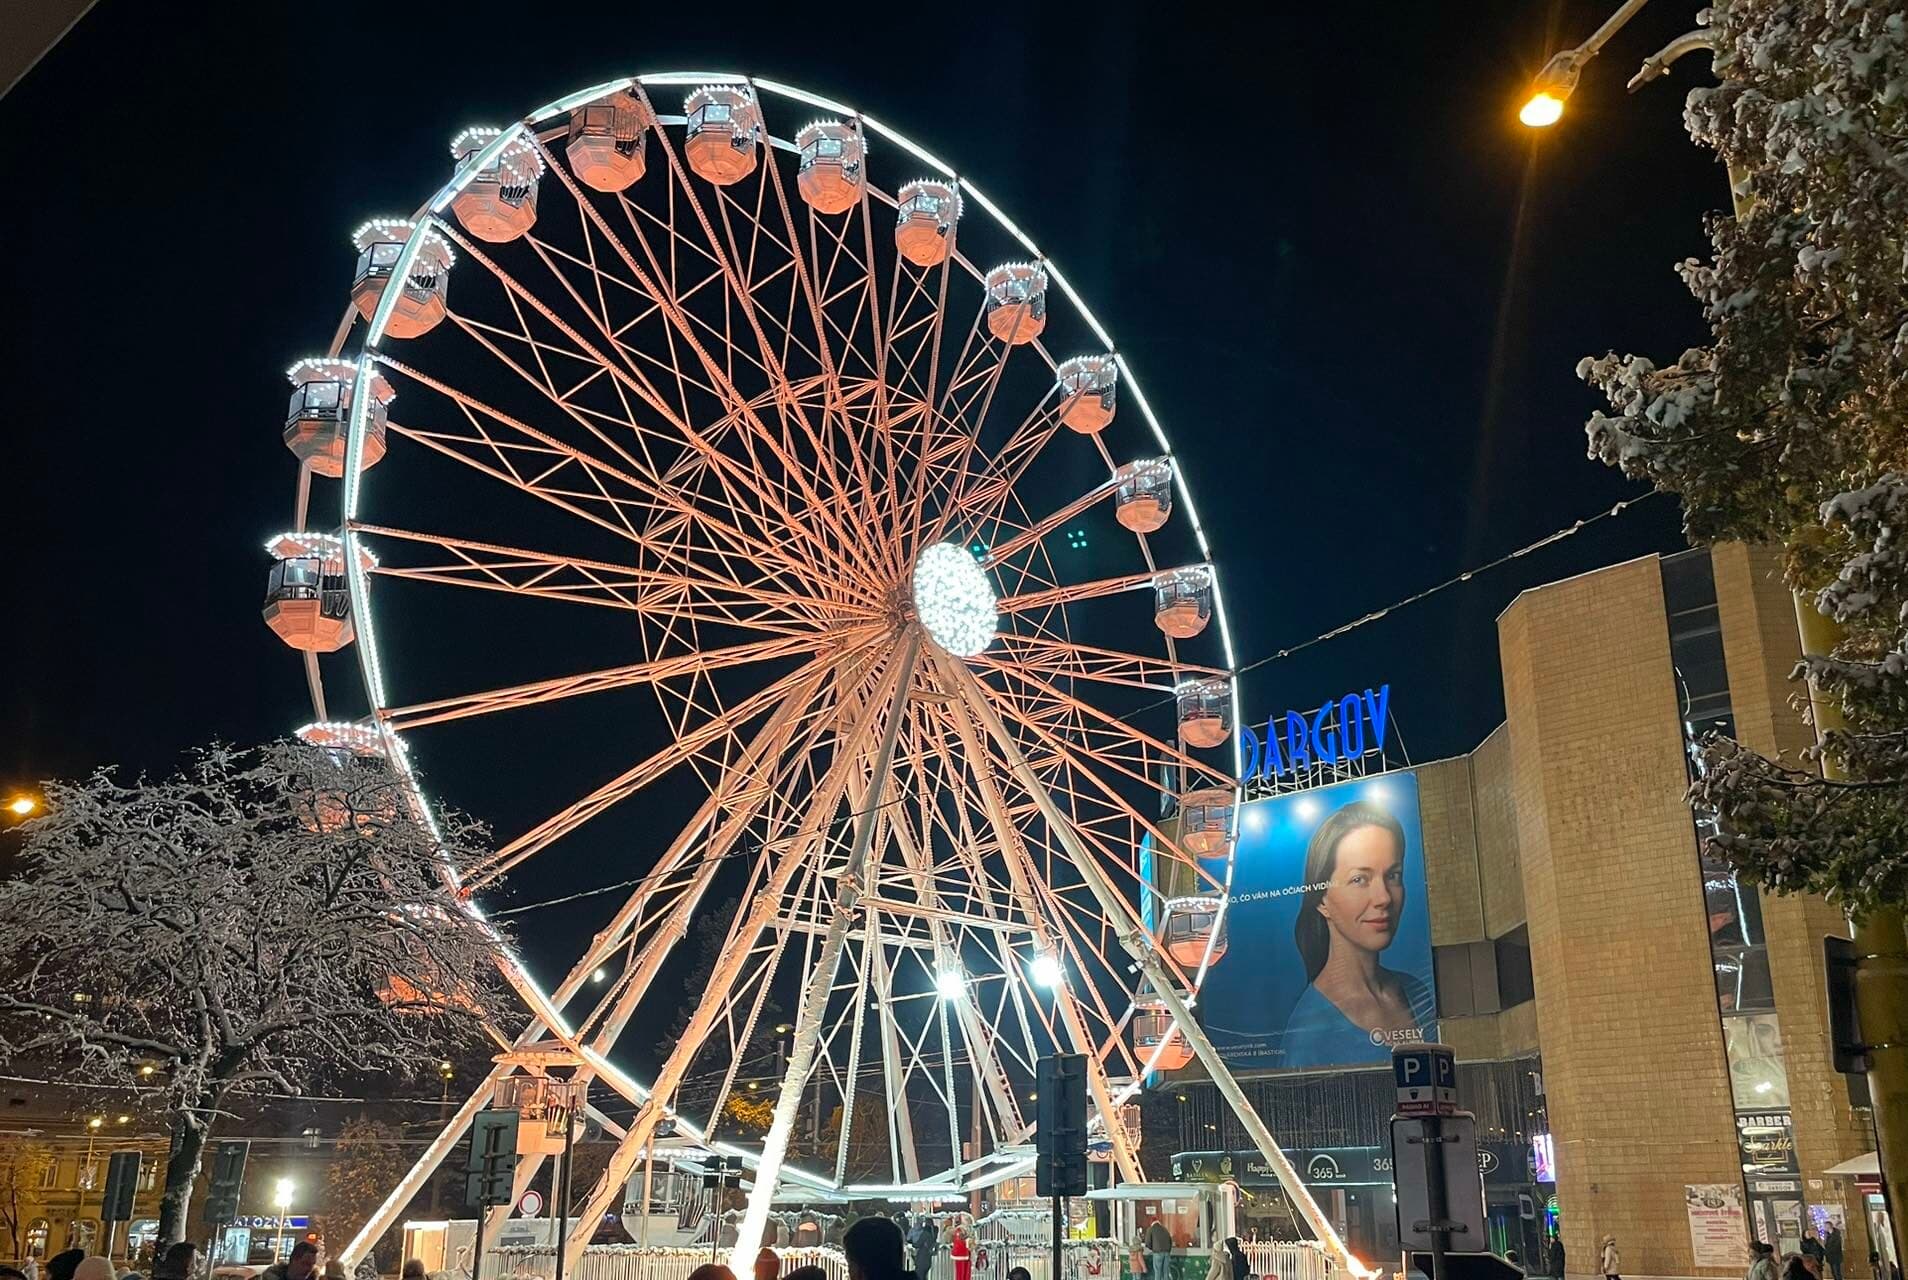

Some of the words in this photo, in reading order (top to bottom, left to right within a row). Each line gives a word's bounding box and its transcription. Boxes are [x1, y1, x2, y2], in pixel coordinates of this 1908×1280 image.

[1240, 684, 1389, 785] DARGOV
[1269, 889, 1282, 899] NA
[1282, 884, 1312, 897] OČIACH
[1383, 1028, 1424, 1040] VESELY
[1403, 1057, 1420, 1083] P
[1439, 1058, 1449, 1083] P
[1736, 1115, 1792, 1128] BARBER
[1313, 1167, 1333, 1179] 365
